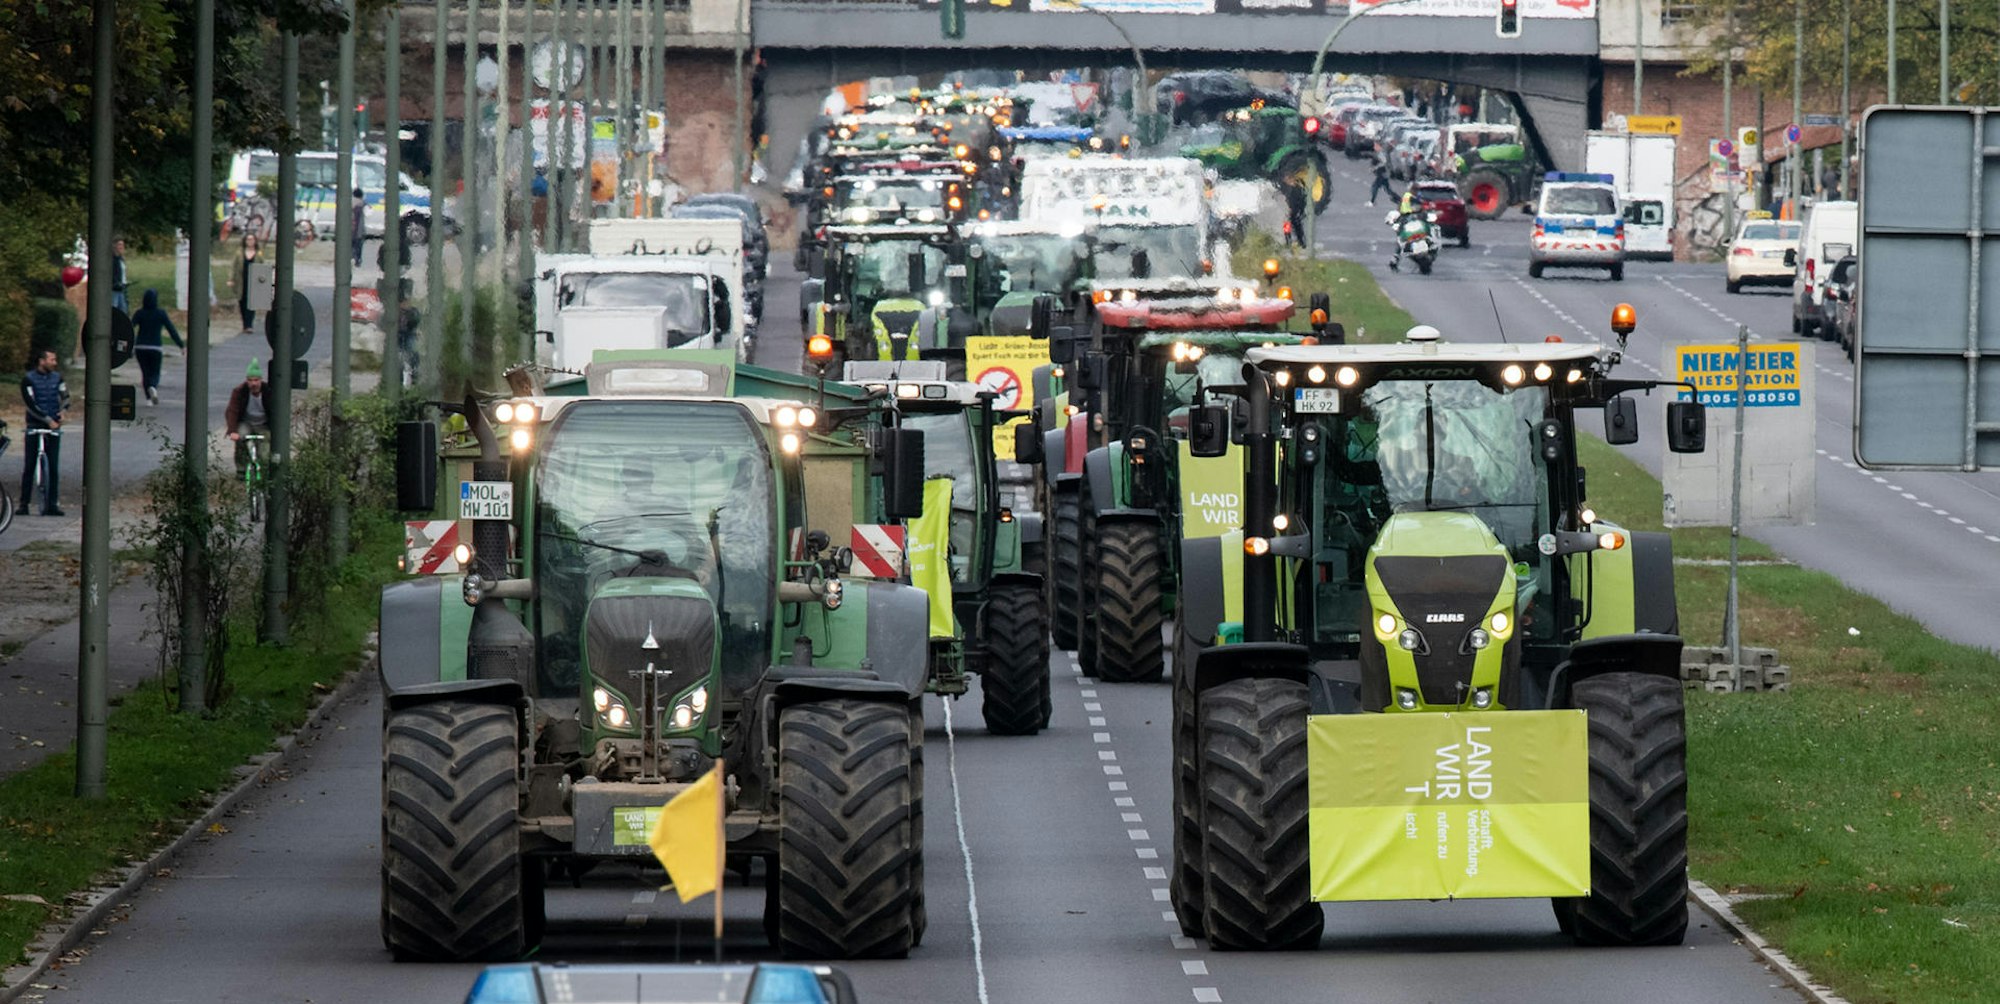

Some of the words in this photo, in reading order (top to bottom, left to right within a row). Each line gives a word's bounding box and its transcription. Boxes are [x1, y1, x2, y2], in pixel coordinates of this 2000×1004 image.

[1682, 352, 1796, 371] NIEMEIER
[1386, 367, 1476, 377] AXION
[1305, 390, 1319, 399] FF
[1301, 401, 1318, 411] HK
[1319, 402, 1333, 411] 92
[469, 485, 500, 500] MOL
[1190, 491, 1239, 508] LAND
[463, 502, 480, 516] MW
[484, 502, 510, 517] 101
[1202, 508, 1240, 524] WIR
[1426, 613, 1465, 622] CLAAS
[1466, 726, 1492, 800] LAND
[1435, 743, 1461, 800] WIR
[1405, 780, 1430, 798] T
[624, 811, 645, 823] LAND
[1437, 811, 1449, 843] rufen
[1480, 809, 1493, 849] schafft
[1465, 808, 1480, 878] Verbindung.
[1438, 845, 1448, 859] zu
